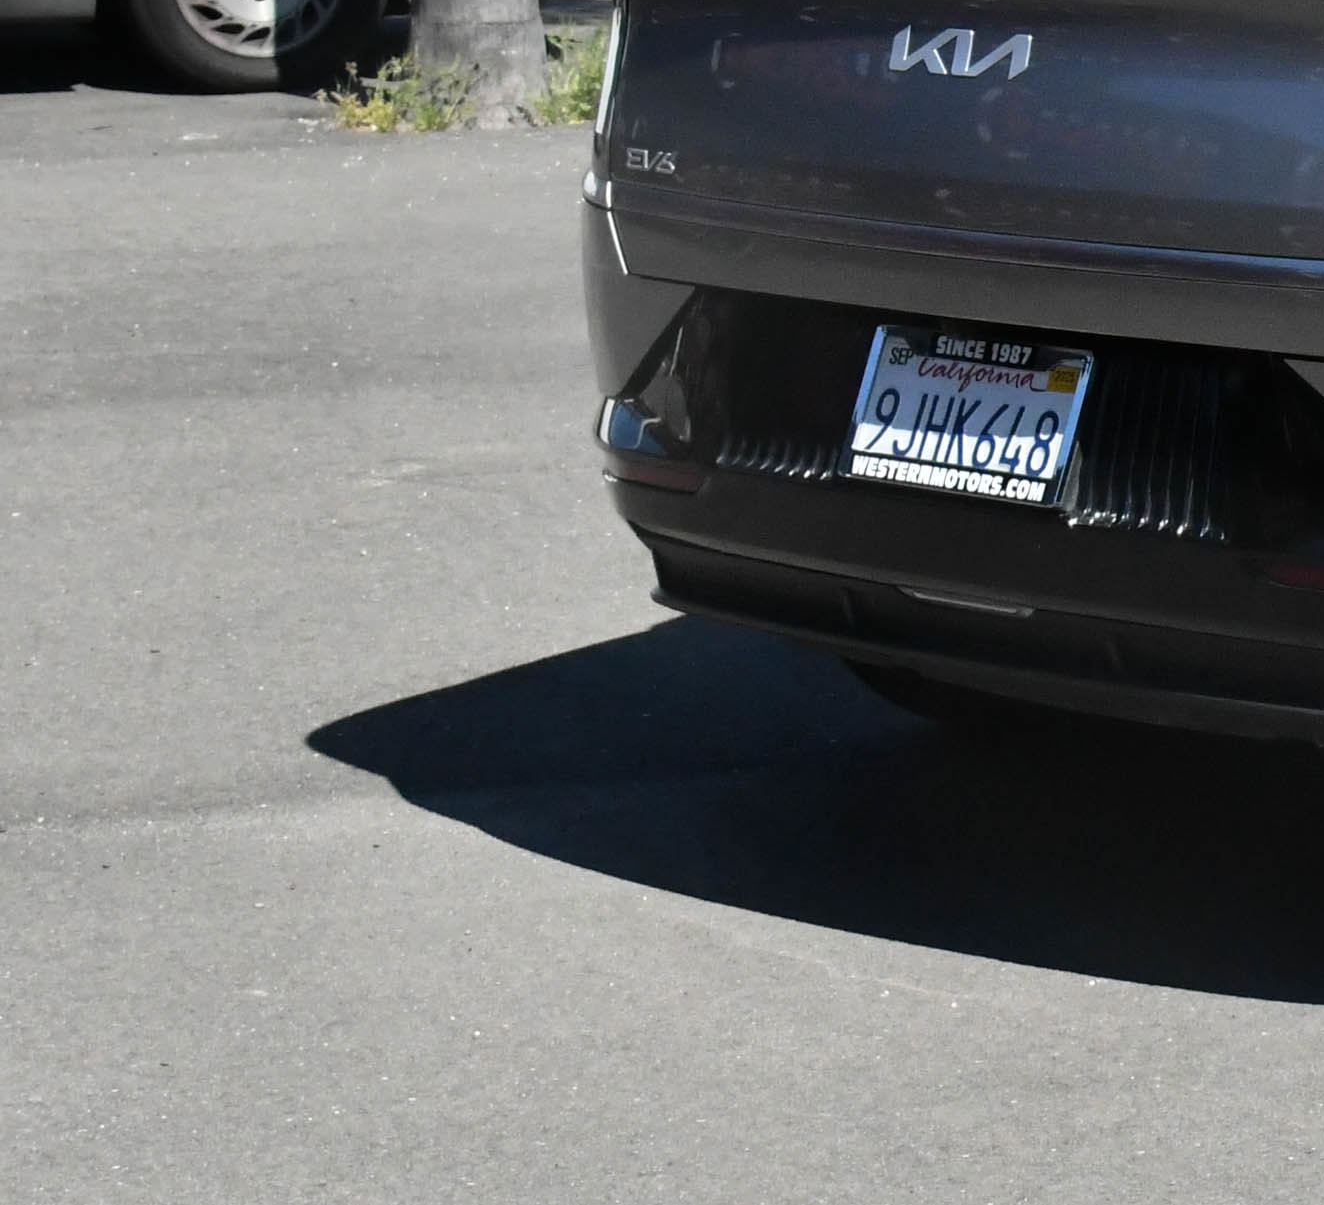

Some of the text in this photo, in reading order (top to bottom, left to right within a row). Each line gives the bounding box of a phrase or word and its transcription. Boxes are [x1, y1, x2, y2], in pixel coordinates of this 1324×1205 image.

[626, 147, 678, 175] EV6
[889, 346, 915, 366] SEP
[935, 335, 1033, 365] SINCE 1987
[918, 357, 1048, 393] California
[864, 387, 1060, 478] 9JHK648
[851, 454, 1046, 502] WESTERNMOTORS.COM
